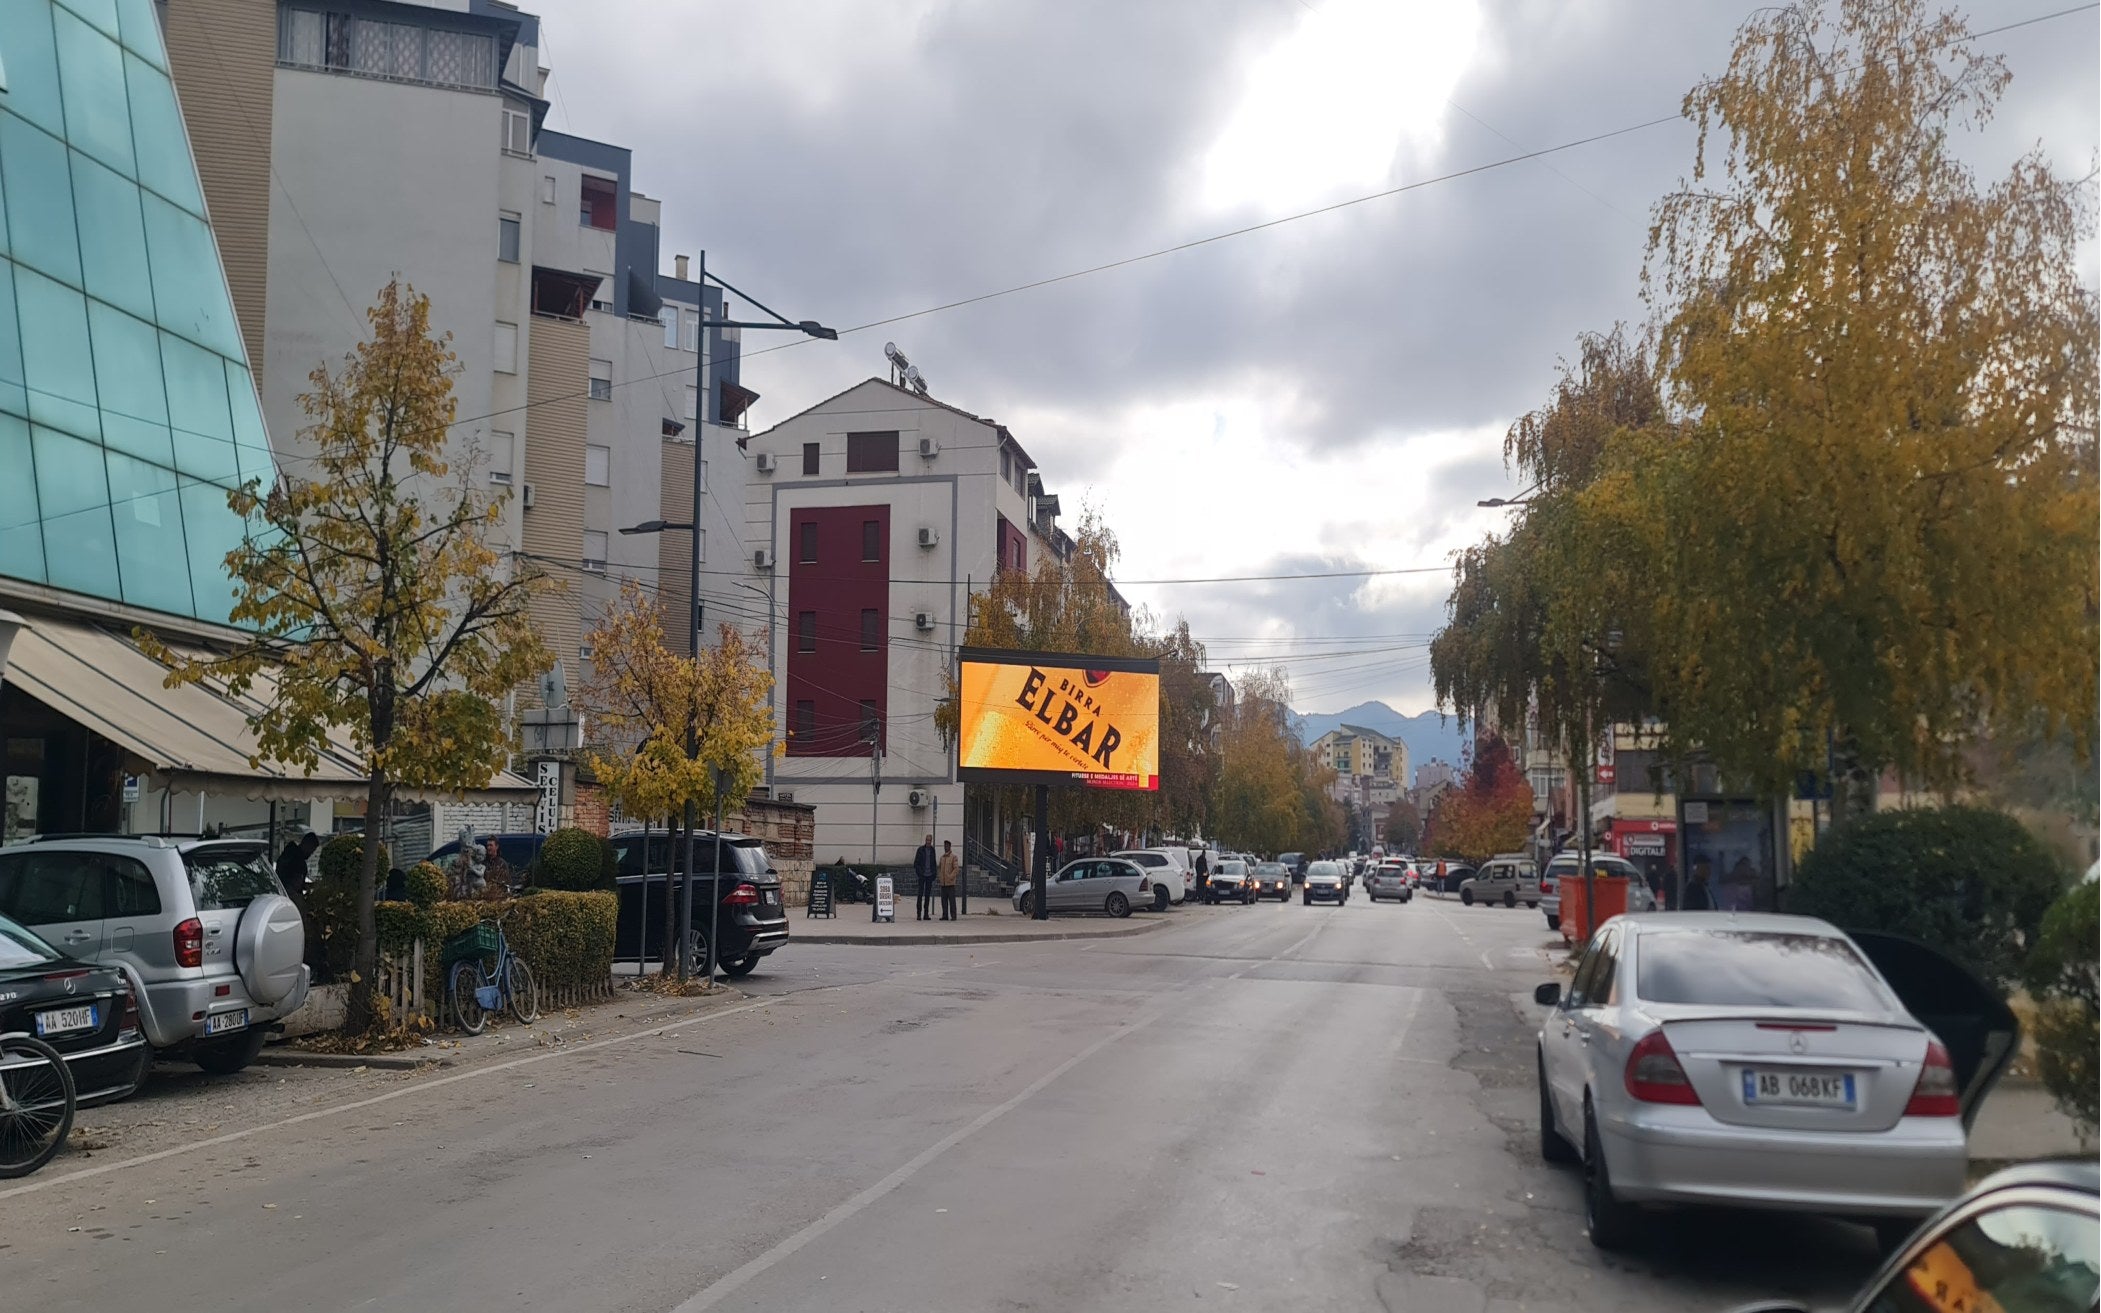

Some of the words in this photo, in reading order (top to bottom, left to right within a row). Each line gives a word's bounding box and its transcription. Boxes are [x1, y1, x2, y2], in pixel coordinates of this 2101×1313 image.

[1060, 678, 1102, 717] BIRRA
[1015, 666, 1121, 770] ELBAR
[1760, 1076, 1780, 1096] AB
[1789, 1076, 1841, 1098] 068KF
